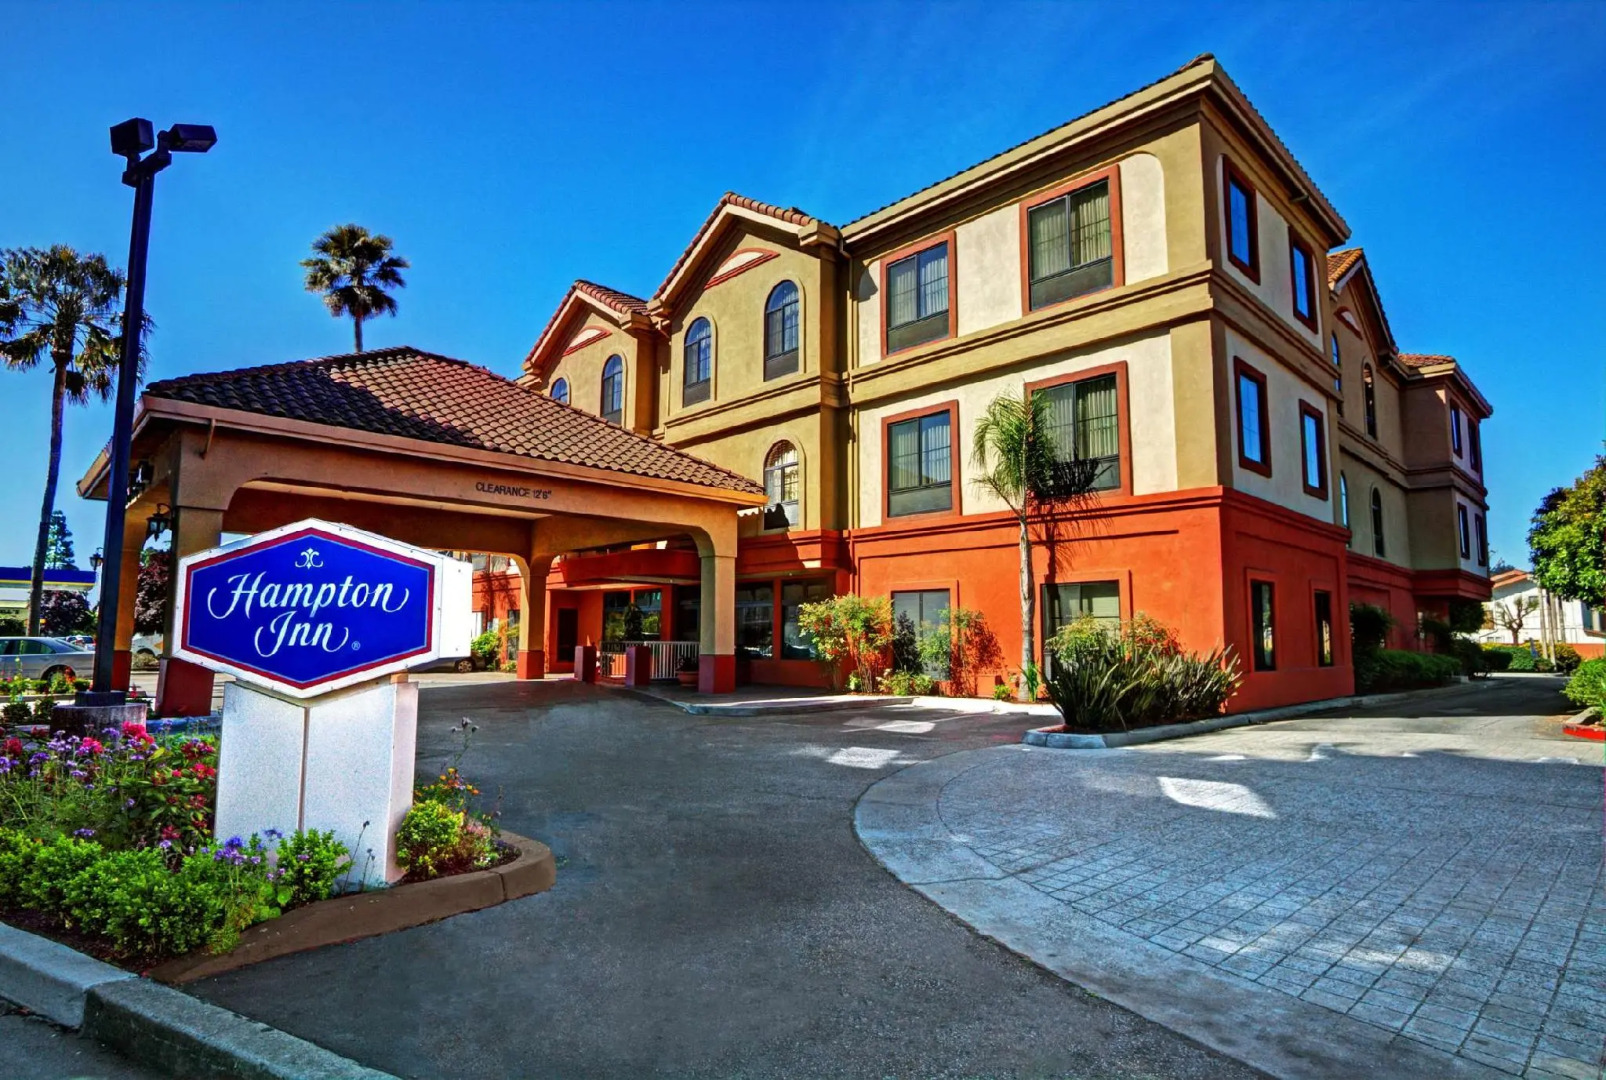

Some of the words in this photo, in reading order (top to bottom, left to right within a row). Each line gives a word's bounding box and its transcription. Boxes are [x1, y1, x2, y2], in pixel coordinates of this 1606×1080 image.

[475, 482, 530, 498] CLEARANCE
[207, 571, 409, 619] Hampton
[255, 610, 349, 657] Inn
